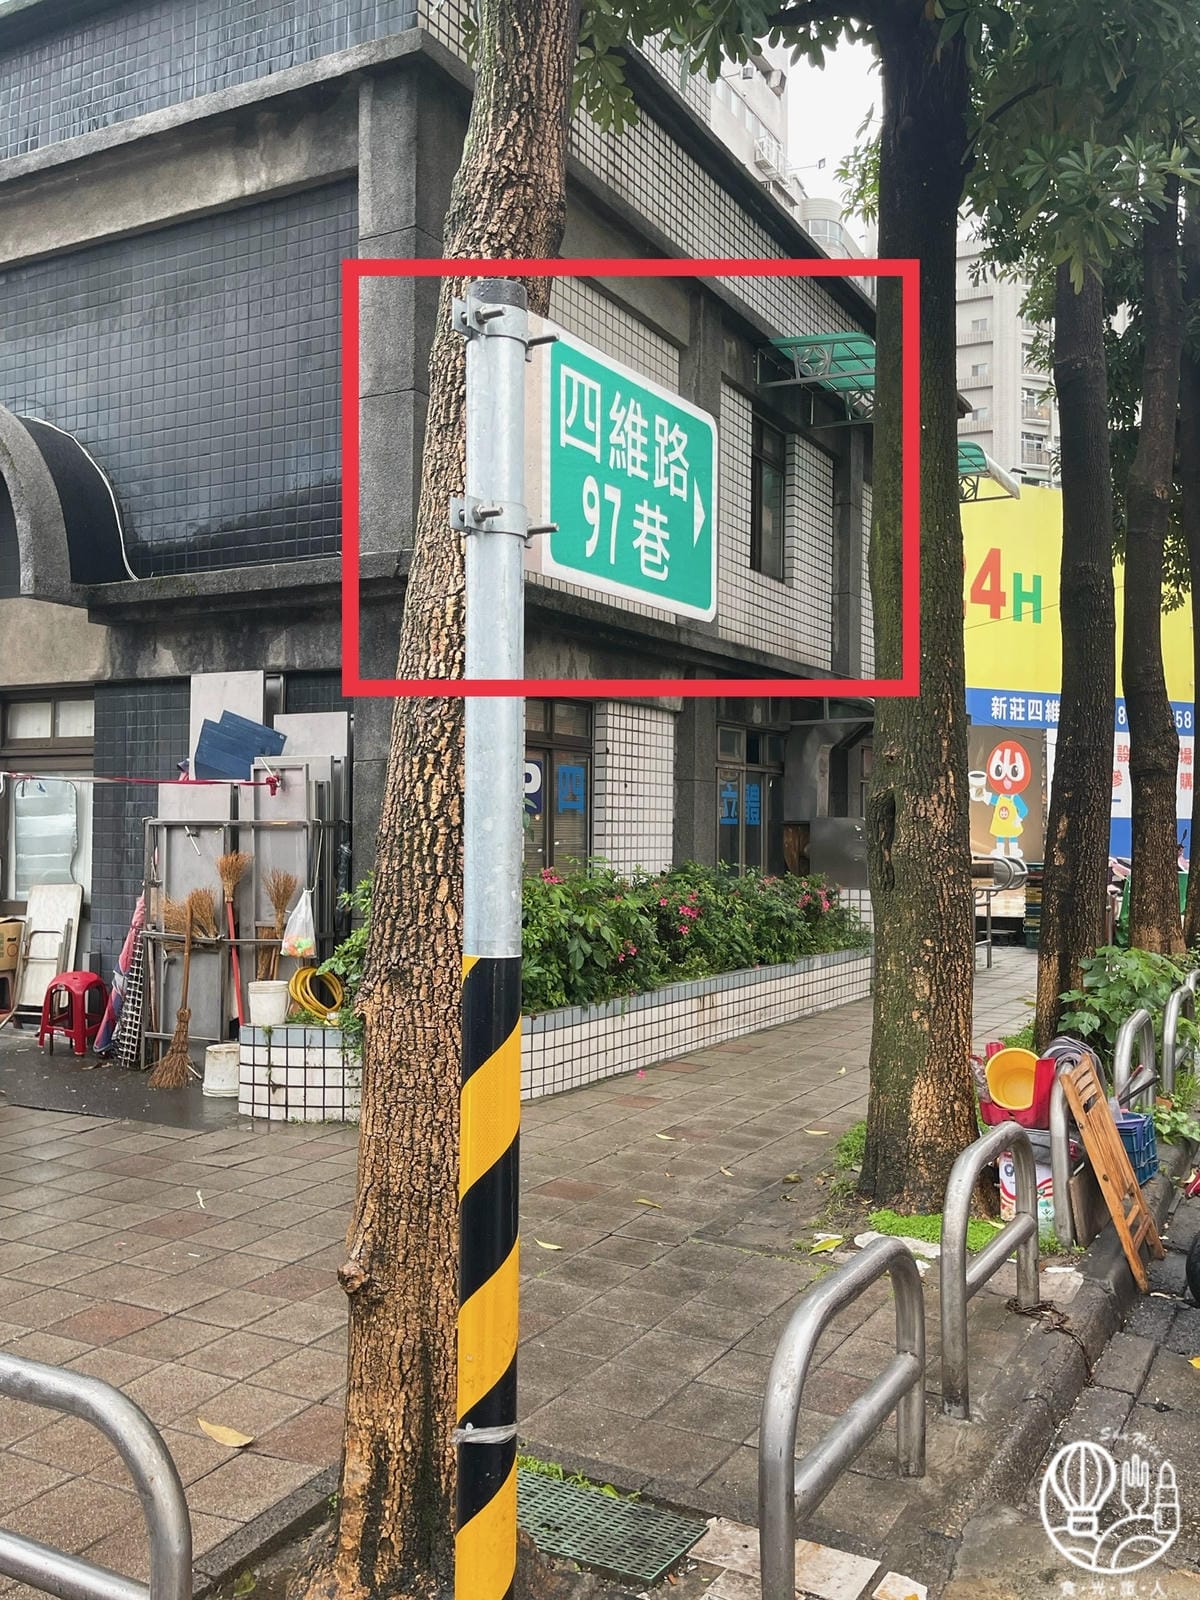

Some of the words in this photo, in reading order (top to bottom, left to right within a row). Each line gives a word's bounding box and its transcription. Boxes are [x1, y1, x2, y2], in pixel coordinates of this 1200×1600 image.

[560, 364, 689, 502] 四維路
[963, 547, 1042, 624] 4H
[991, 695, 1061, 723] 新莊四維
